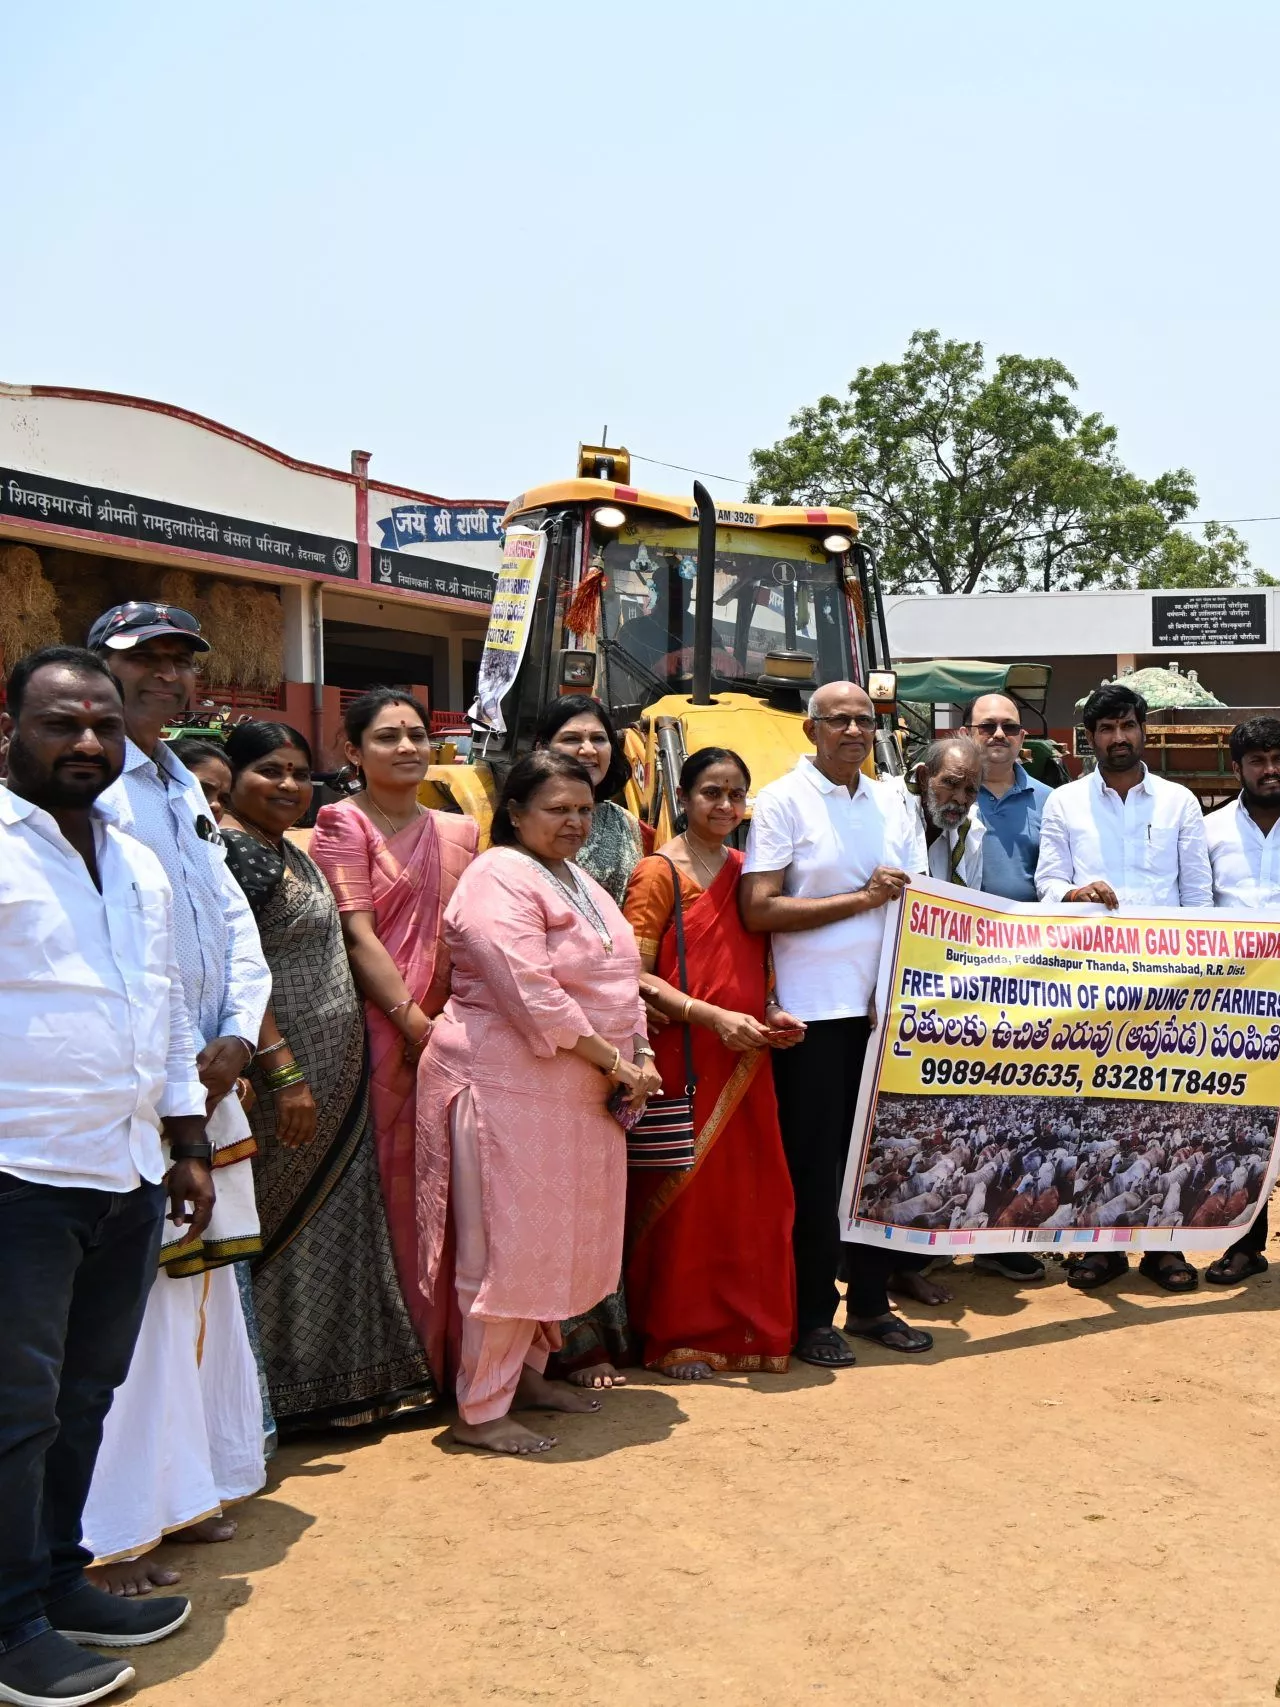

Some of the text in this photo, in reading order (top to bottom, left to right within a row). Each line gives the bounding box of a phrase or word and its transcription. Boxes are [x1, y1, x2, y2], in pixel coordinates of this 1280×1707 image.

[8, 479, 93, 519] शिवकुमारजी
[97, 499, 138, 527] श्रीमती
[142, 513, 219, 543] रामदुलारीदेवी
[223, 526, 251, 549] बंसल
[255, 533, 294, 559] परिवार,
[395, 511, 427, 536] जय
[433, 508, 452, 537] श्री
[718, 509, 731, 521] AM
[734, 511, 754, 524] 3926
[909, 901, 972, 944] SATYAM
[975, 917, 1042, 949] SHIVAM
[1046, 924, 1141, 954] SUNDARAM
[1145, 928, 1180, 956] GAU
[1185, 929, 1230, 957] SEVA
[946, 948, 1246, 977] Burjugadda, Peddashapur Thanda, Shamshabad, R.R. Dist.
[900, 967, 946, 998] FREE
[950, 974, 1072, 1008] DISTRIBUTION
[1077, 983, 1099, 1010] OF
[1104, 985, 1143, 1011] COW
[1143, 988, 1189, 1012] DUNG
[1189, 987, 1210, 1012] TO
[893, 1004, 987, 1057] రైతులకు
[991, 1010, 1053, 1051] ఉచిత
[1051, 1018, 1114, 1058] ఎరువు
[1115, 1014, 1207, 1060] (ఆవుపేడ)
[921, 1057, 1248, 1096] 9989403635, 8328178495
